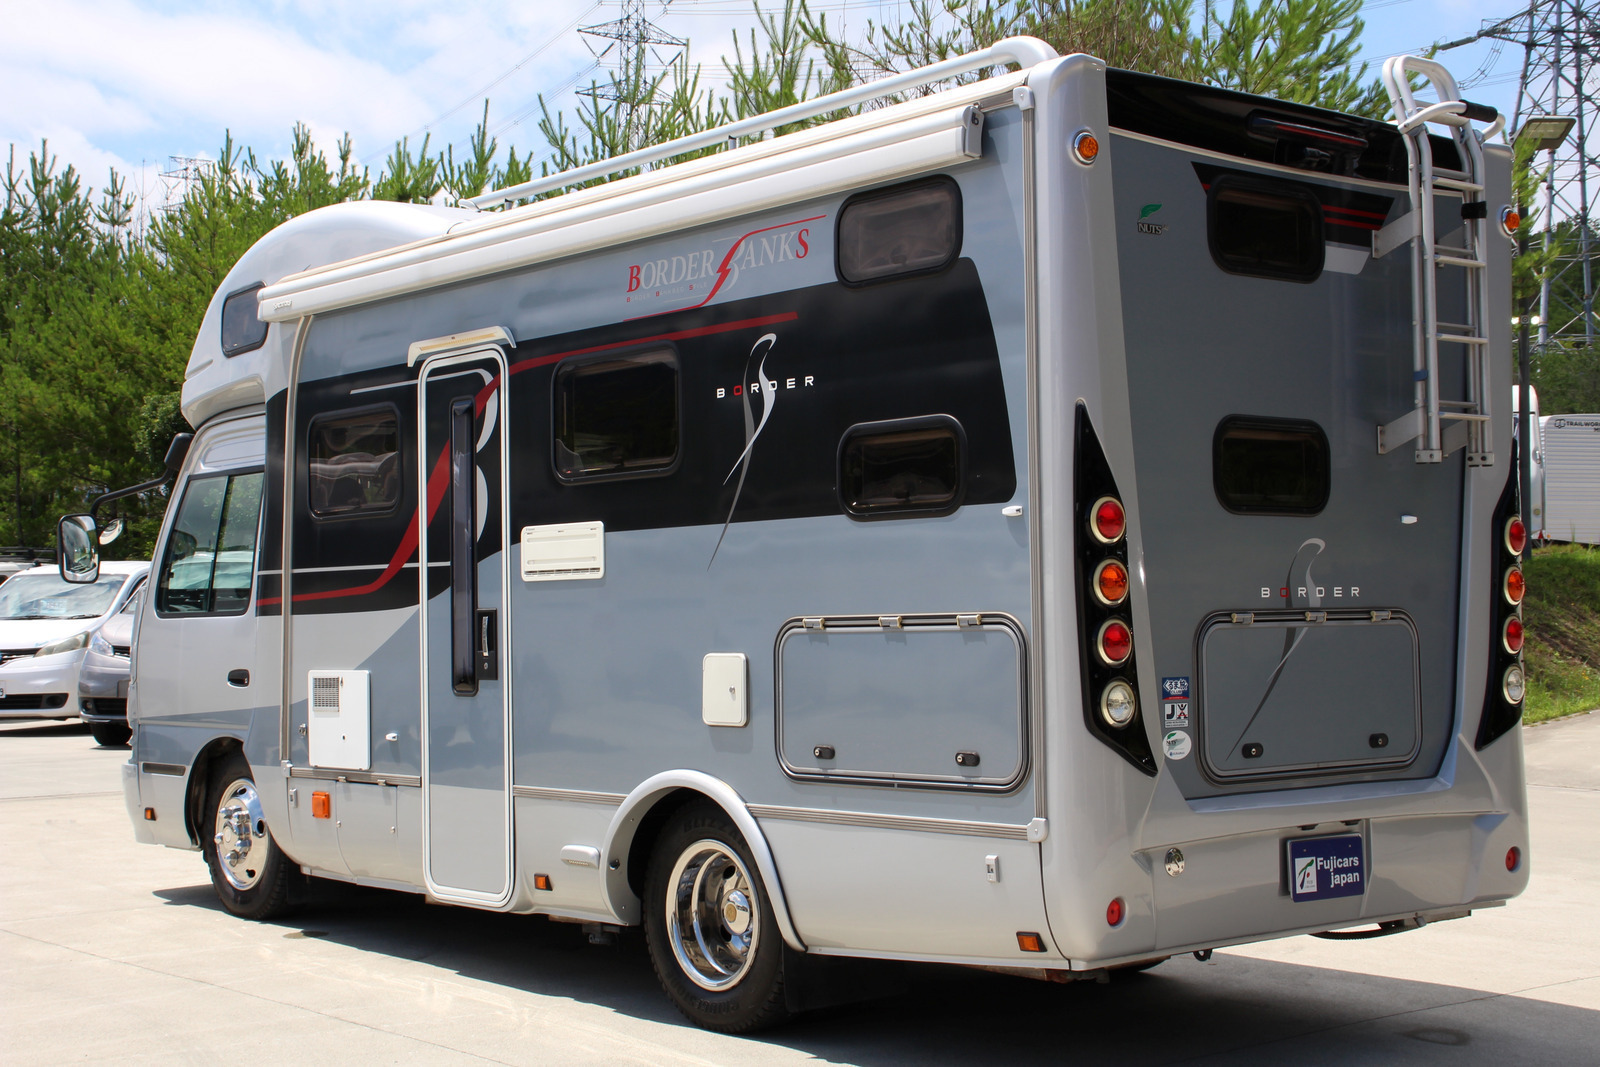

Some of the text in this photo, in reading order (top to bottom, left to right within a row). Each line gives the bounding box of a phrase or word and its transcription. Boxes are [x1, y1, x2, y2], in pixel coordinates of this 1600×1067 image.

[1138, 223, 1162, 235] NUTS
[626, 249, 714, 292] BORDER
[716, 375, 814, 399] BORDER
[1261, 586, 1360, 598] BORDER
[1317, 856, 1359, 872] Fujicars
[1330, 872, 1360, 888] japan
